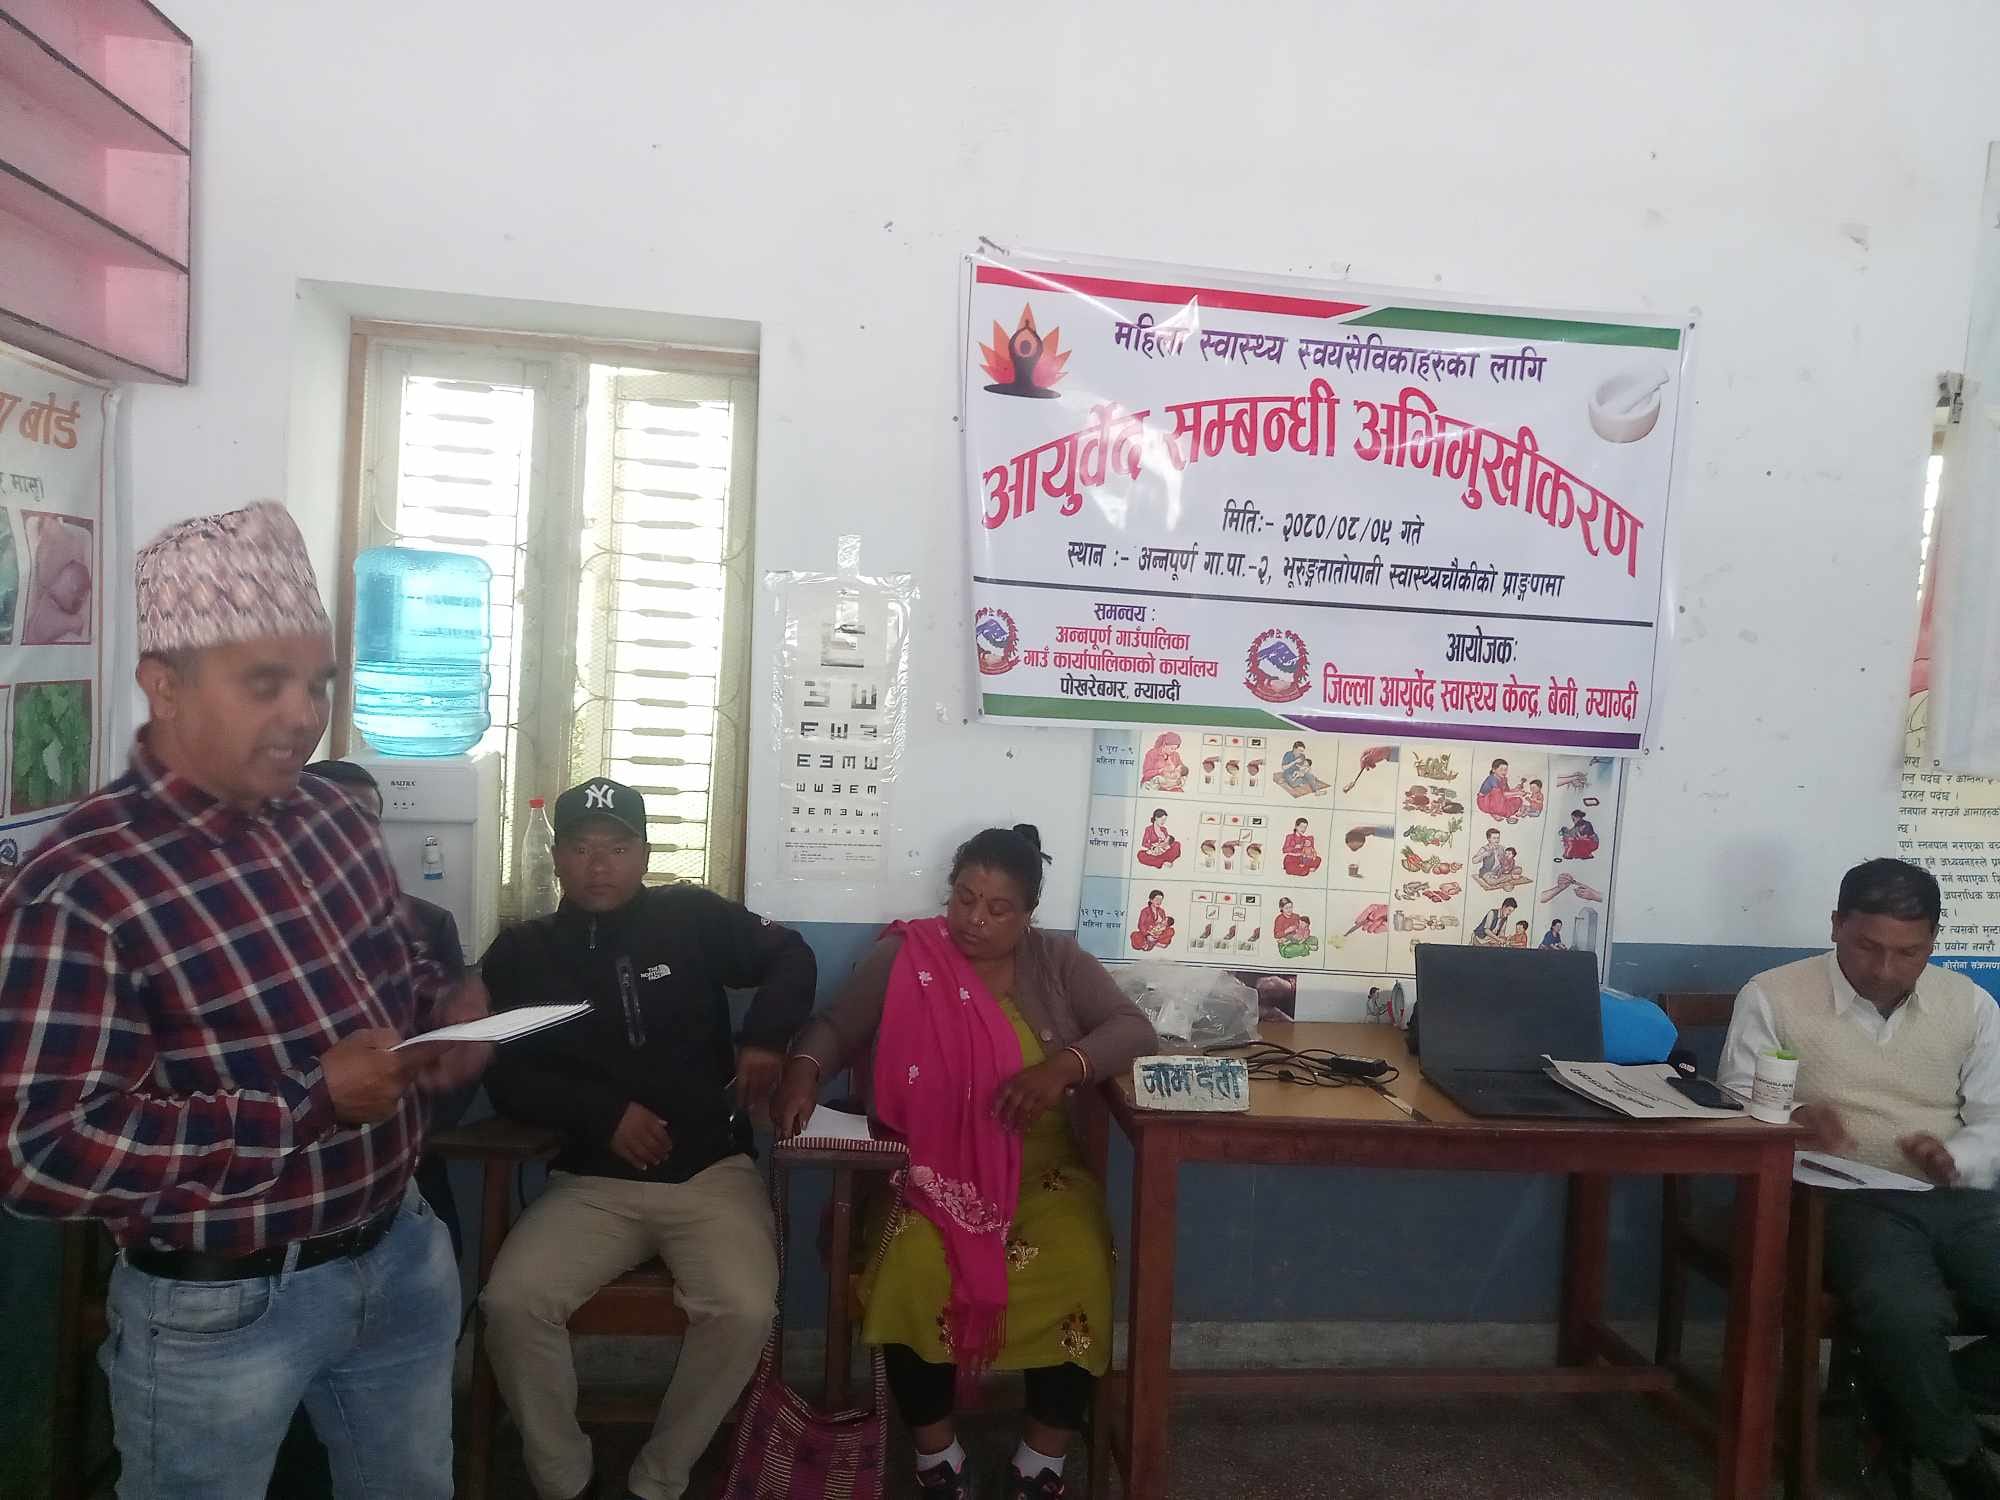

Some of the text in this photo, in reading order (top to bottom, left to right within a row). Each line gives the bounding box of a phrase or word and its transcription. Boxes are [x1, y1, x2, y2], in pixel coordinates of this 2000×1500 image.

[1115, 313, 1190, 359] महिला
[1200, 330, 1287, 364] स्वास्थ्य
[1490, 346, 1547, 382] लागि
[1165, 378, 1340, 471] सम्बन्धी
[1353, 387, 1644, 577] अभिमुखीकरण
[1400, 514, 1424, 546] गते
[1139, 542, 1199, 581] अन्नपूर्ण
[1390, 557, 1498, 593] स्वास्थ्यचौकीको
[1056, 625, 1191, 650] अन्नपूर्ण गाउँपालिका
[1024, 647, 1049, 668] गाउँ
[1159, 656, 1218, 677] कार्यालय
[1134, 679, 1182, 701] म्याग्दी
[1323, 662, 1375, 706] जिल्ला
[1379, 668, 1436, 716] आयुर्वेद
[1441, 680, 1498, 713] स्वास्थ्य
[1586, 680, 1639, 721] म्याग्दी
